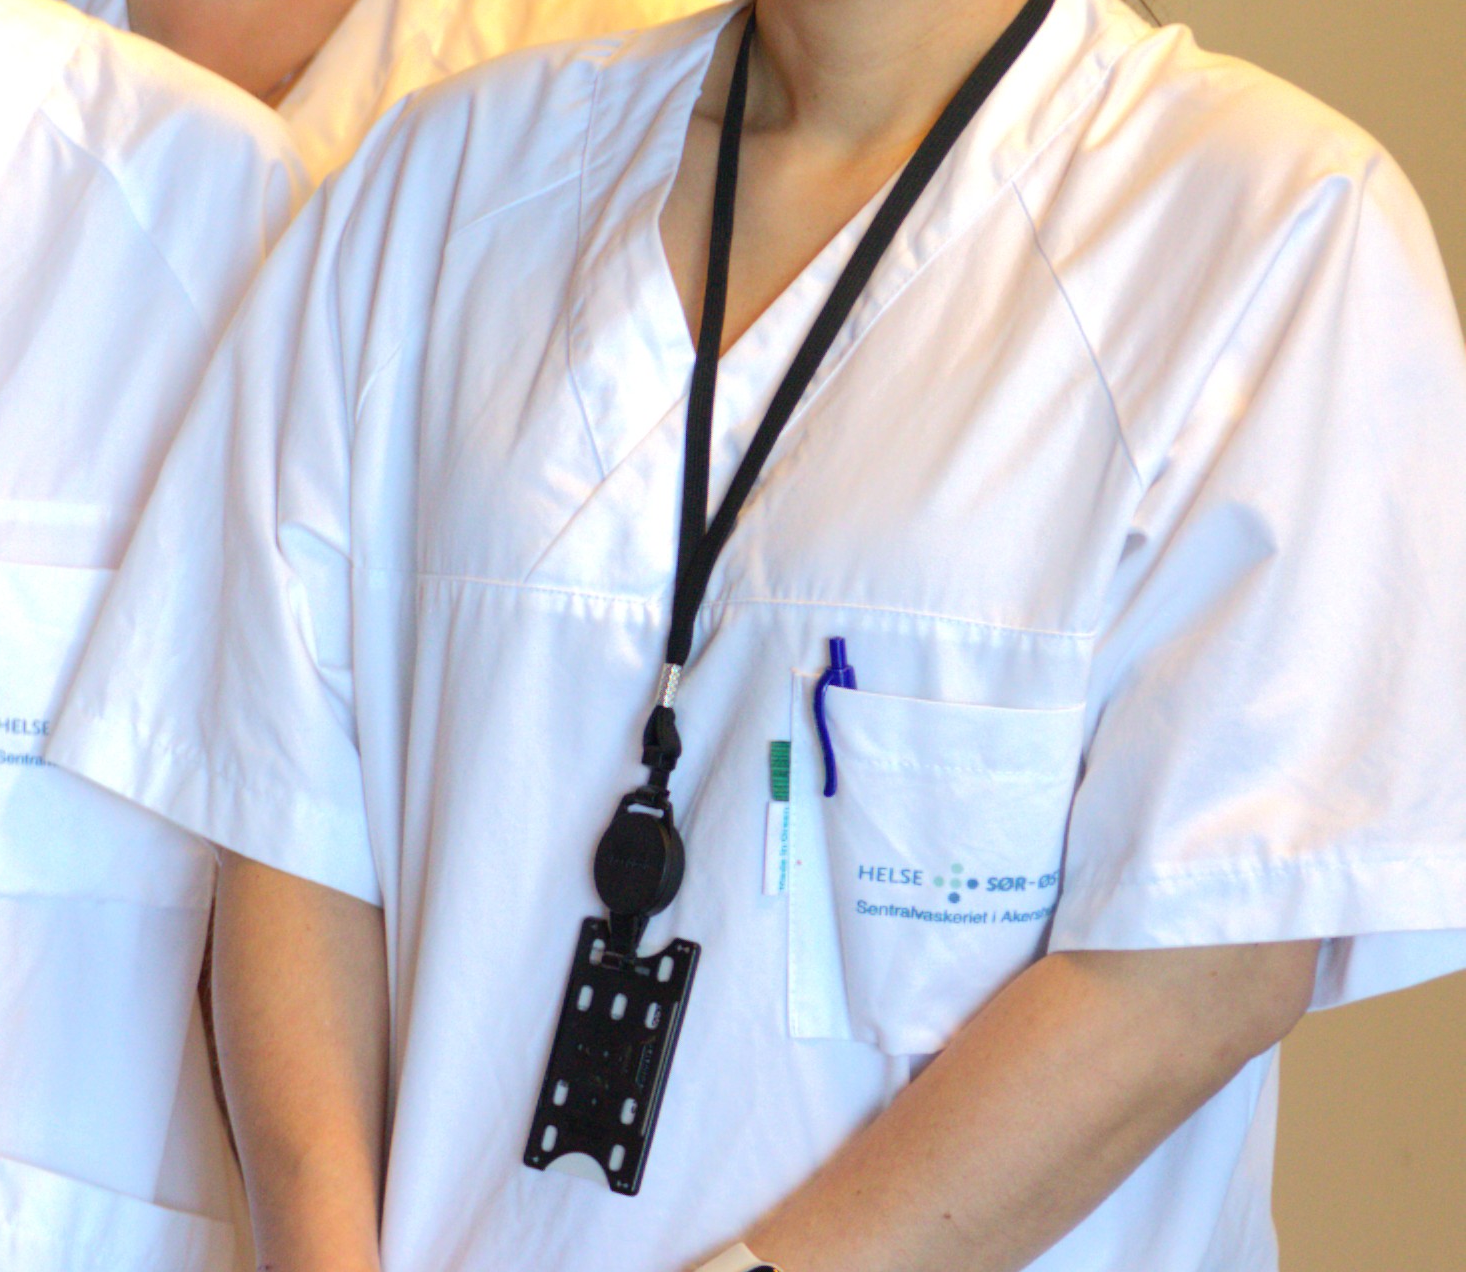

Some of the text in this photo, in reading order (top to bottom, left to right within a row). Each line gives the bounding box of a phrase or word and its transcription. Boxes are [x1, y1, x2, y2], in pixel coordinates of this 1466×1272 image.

[858, 864, 1059, 892] HELSE SØR-ØS
[857, 899, 988, 925] Sentralvaskeriet
